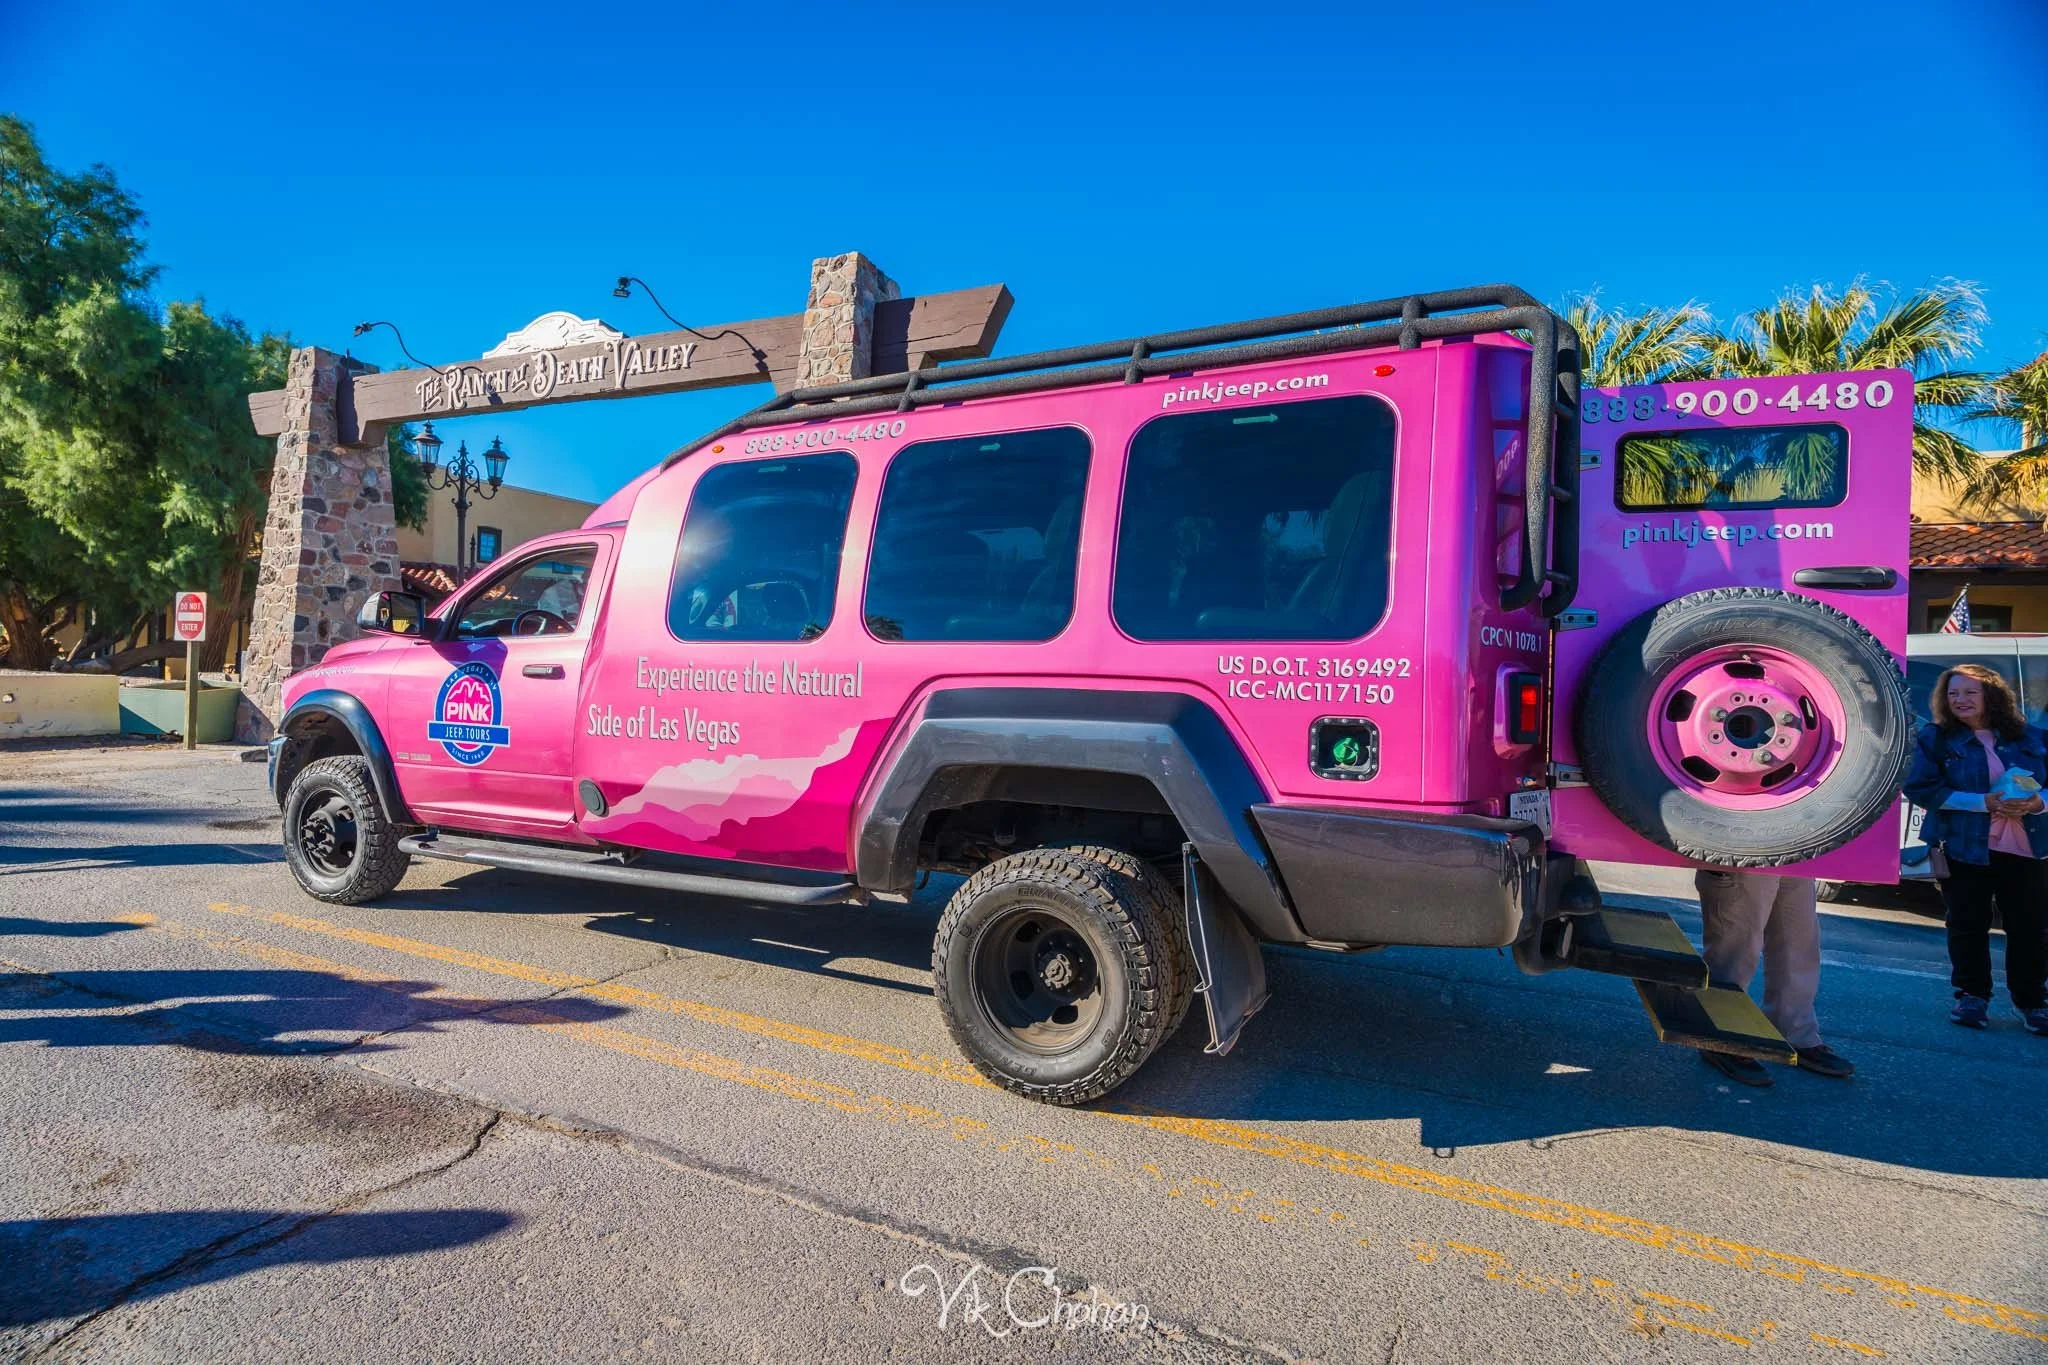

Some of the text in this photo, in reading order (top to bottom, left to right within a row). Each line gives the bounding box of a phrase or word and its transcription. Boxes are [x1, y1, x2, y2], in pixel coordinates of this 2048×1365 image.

[416, 338, 698, 410] THE RANCH AT DEATH VALLEY
[1162, 373, 1330, 408] pinkjeep.com
[1622, 518, 1834, 549] pinkjeep.com
[180, 602, 201, 610] DO NOT
[181, 623, 198, 632] ENTER
[1480, 626, 1512, 649] CPCN
[636, 656, 863, 698] Experience the Natural
[1218, 655, 1411, 678] US D.O.T. 3169492
[1228, 679, 1395, 705] ICC-MC117150
[446, 701, 491, 722] PINK
[466, 727, 491, 741] TOURS
[587, 703, 741, 751] Side of Las Vegas
[451, 747, 469, 761] SINCE
